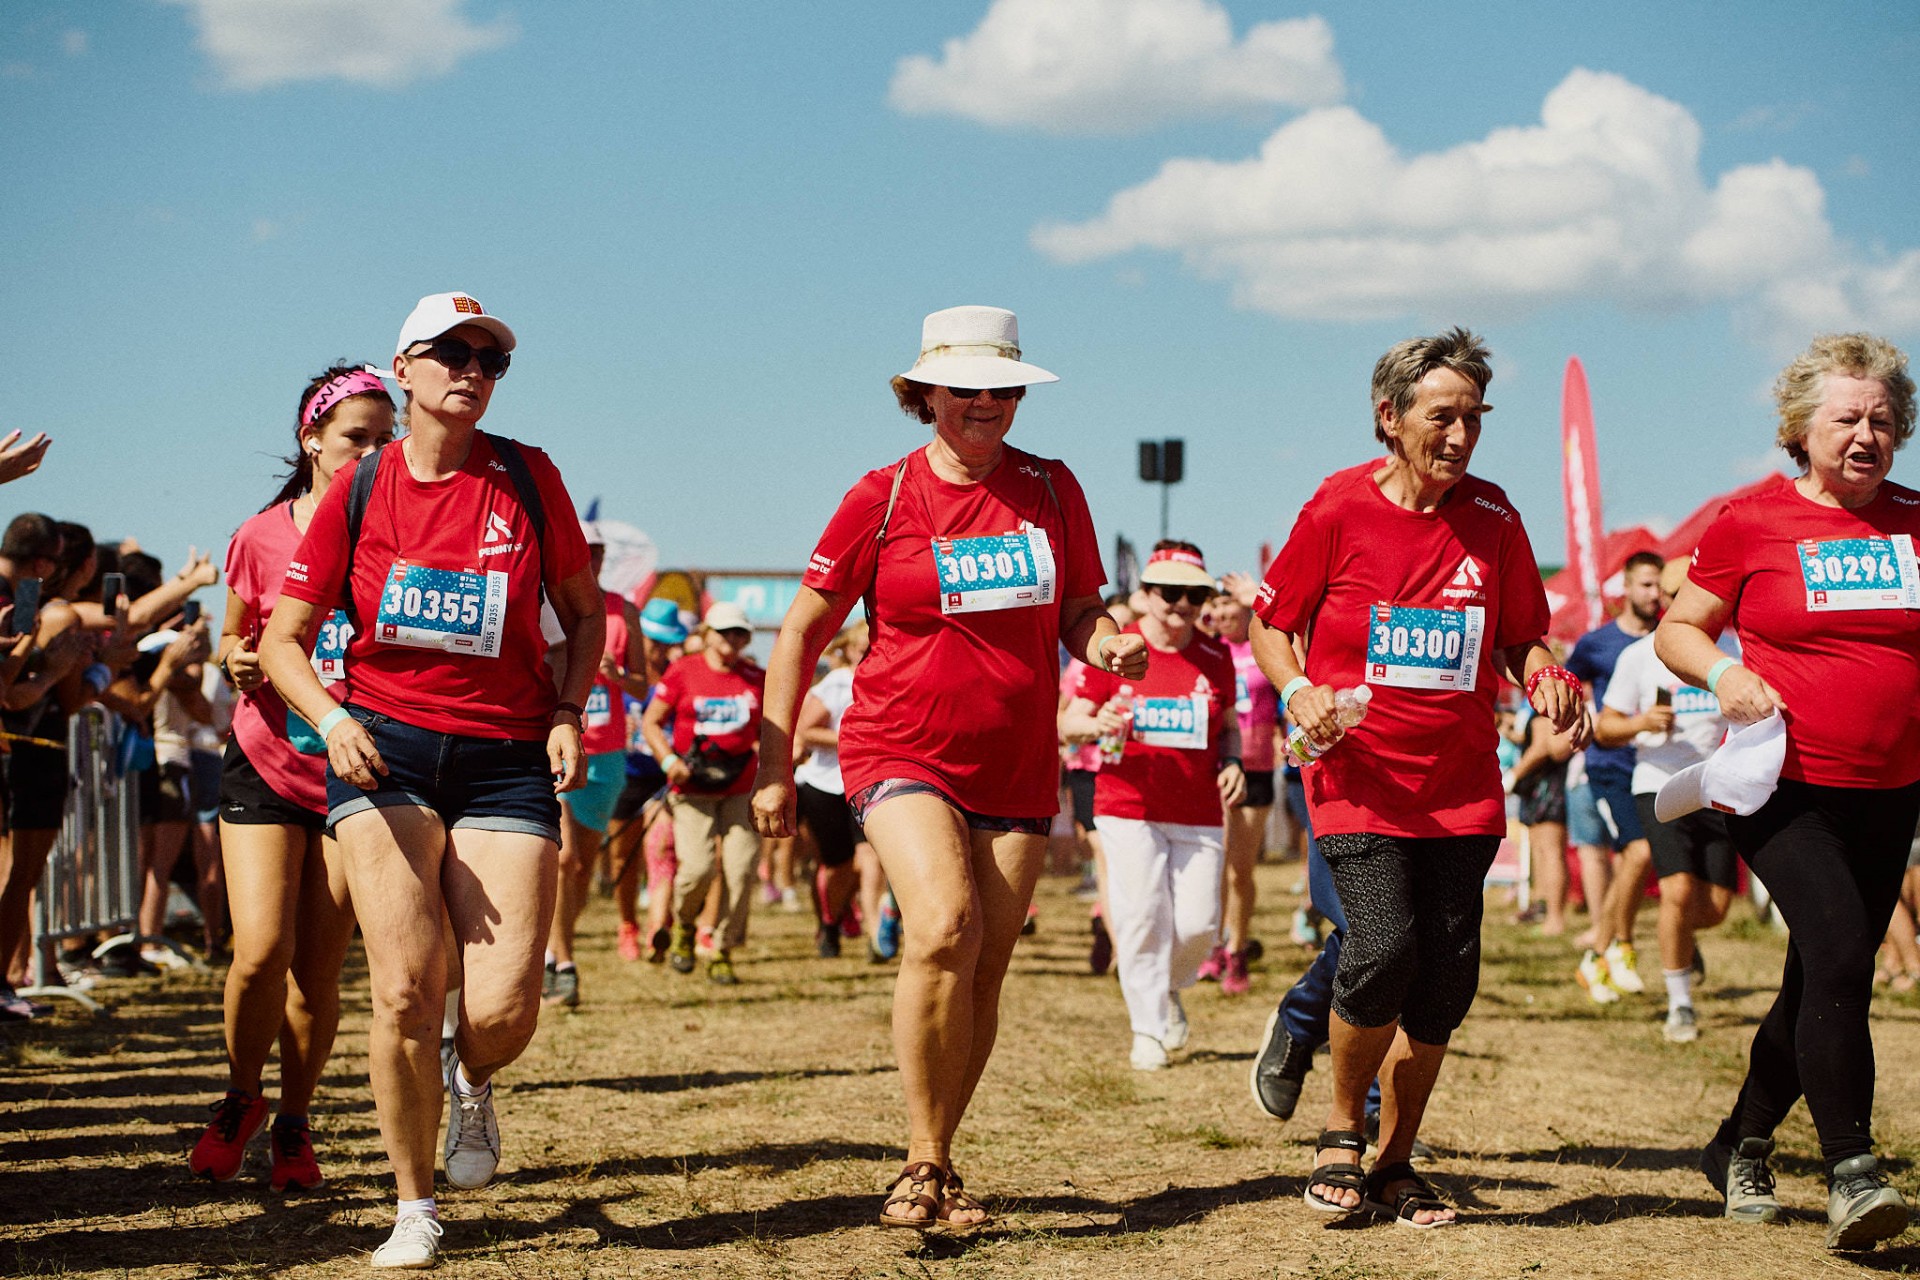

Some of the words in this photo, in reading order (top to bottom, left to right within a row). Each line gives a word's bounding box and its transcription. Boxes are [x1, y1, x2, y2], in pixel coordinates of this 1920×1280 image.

[1474, 496, 1508, 516] CRAFT
[942, 550, 1029, 584] 30301
[1038, 554, 1049, 574] 30301
[1807, 553, 1896, 583] 30296
[1904, 560, 1913, 579] 30296
[491, 576, 501, 598] 30355
[1041, 579, 1050, 601] 30301
[1908, 584, 1917, 604] 30296
[384, 584, 480, 625] 30355
[488, 604, 499, 626] 30355
[1470, 610, 1479, 633] 30300
[484, 631, 496, 652] 30355
[1373, 625, 1461, 660] 30300
[1466, 638, 1476, 659] 30300
[1463, 664, 1472, 686] 30300
